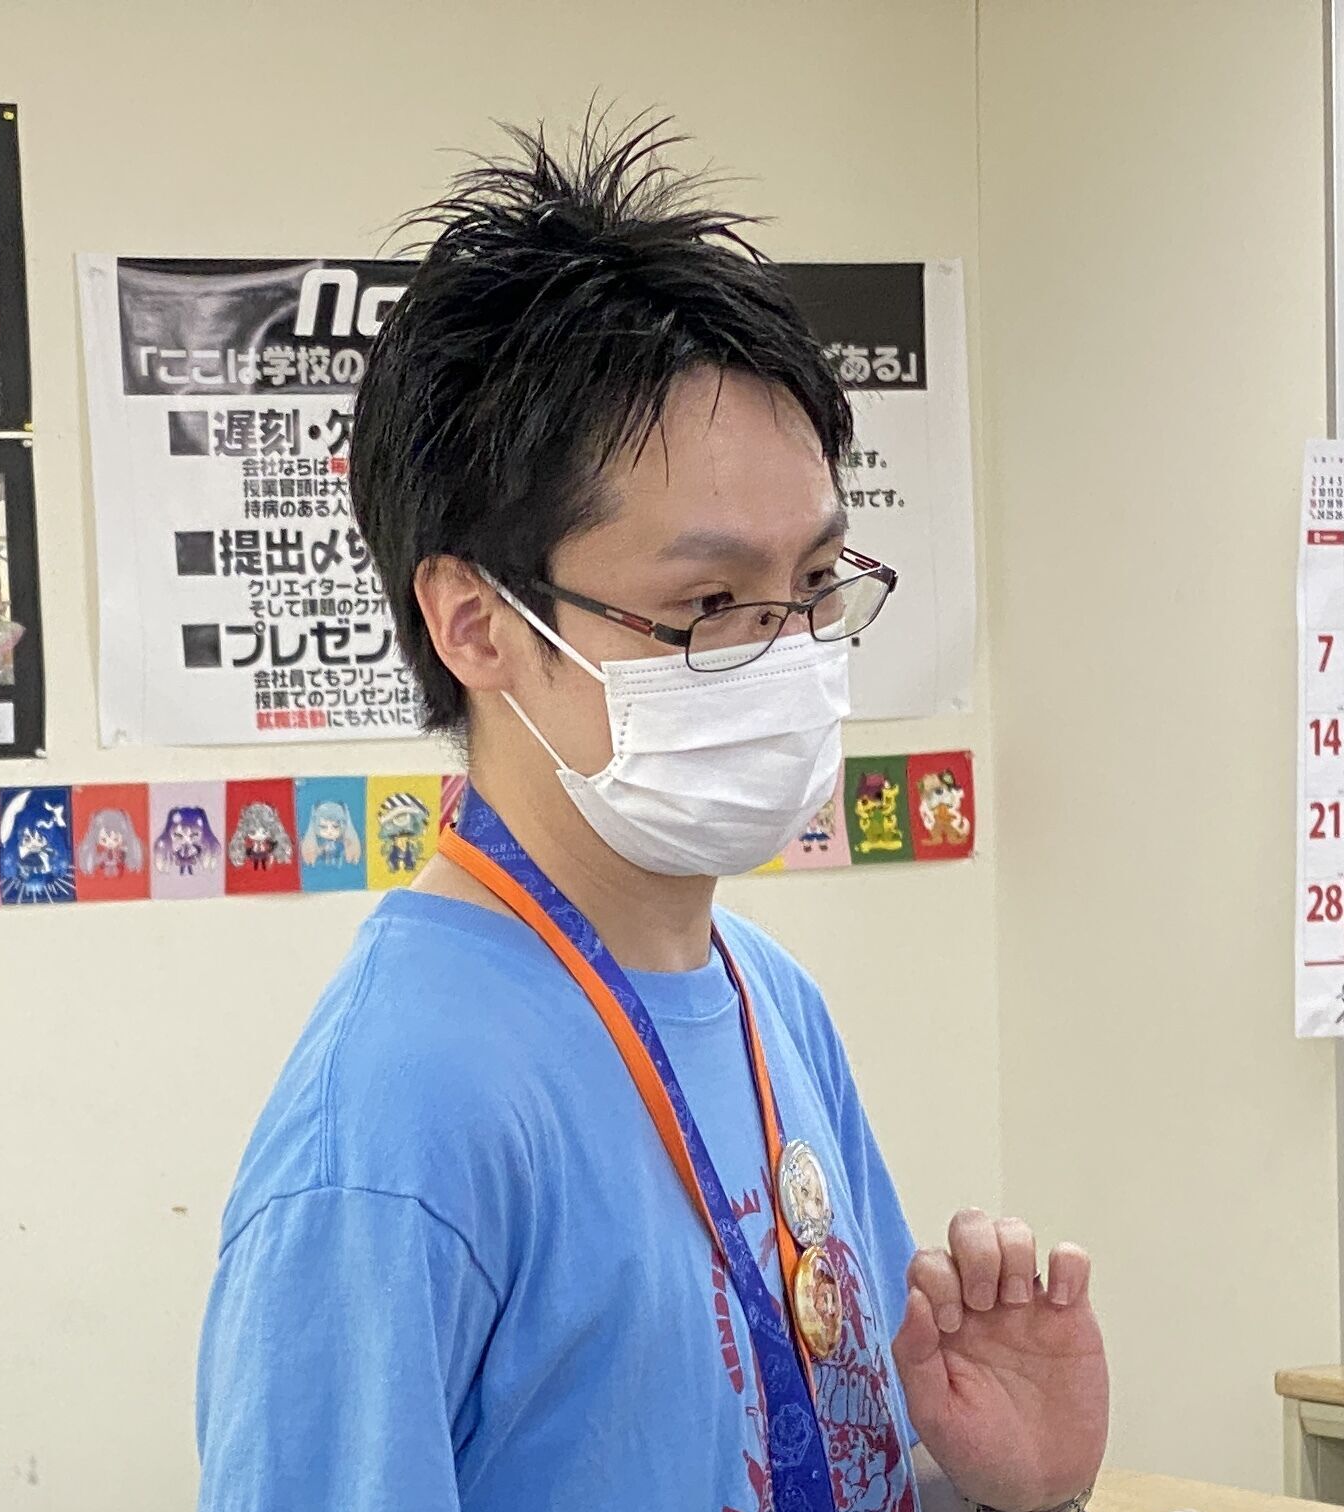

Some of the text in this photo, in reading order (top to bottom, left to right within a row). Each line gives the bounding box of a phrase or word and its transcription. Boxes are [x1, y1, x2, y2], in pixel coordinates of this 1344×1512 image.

[140, 344, 918, 386] 「ここは学校の ある」
[225, 617, 391, 668] プレゼン
[1318, 636, 1333, 672] 7
[1310, 719, 1341, 755] 14
[1310, 802, 1340, 839] 21
[1307, 885, 1343, 922] 28
